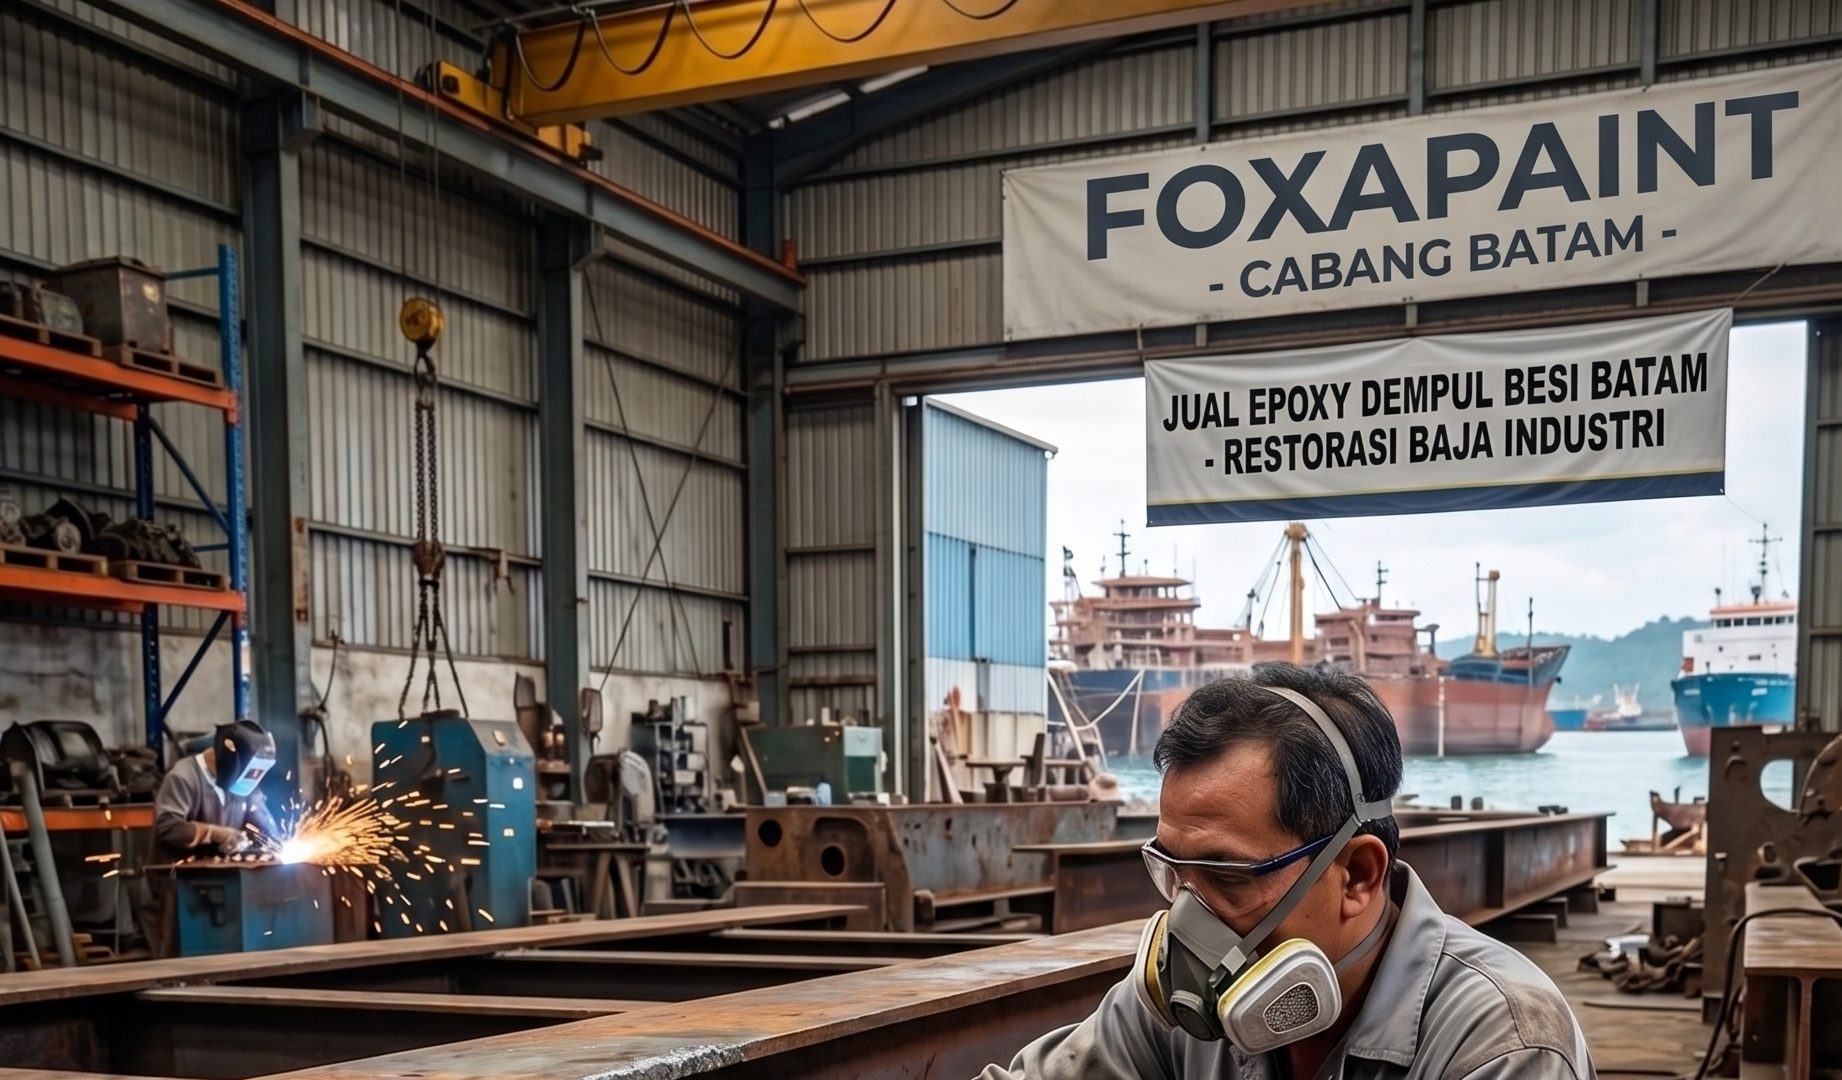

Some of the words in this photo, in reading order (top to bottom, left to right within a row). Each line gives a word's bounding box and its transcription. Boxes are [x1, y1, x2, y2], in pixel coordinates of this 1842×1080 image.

[1086, 91, 1800, 261] FOXAPAINT
[1239, 237, 1452, 298] CABANG
[1468, 214, 1645, 273] BATAM
[1163, 390, 1240, 433] JUAL
[1249, 378, 1350, 424] EPOXY
[1362, 369, 1493, 419] DEMPUL
[1504, 363, 1579, 406] BESI
[1592, 352, 1709, 401] BATAM
[1224, 426, 1399, 475] RESTORASI
[1408, 418, 1495, 462] BAJA
[1504, 408, 1666, 456] INDUSTRI
